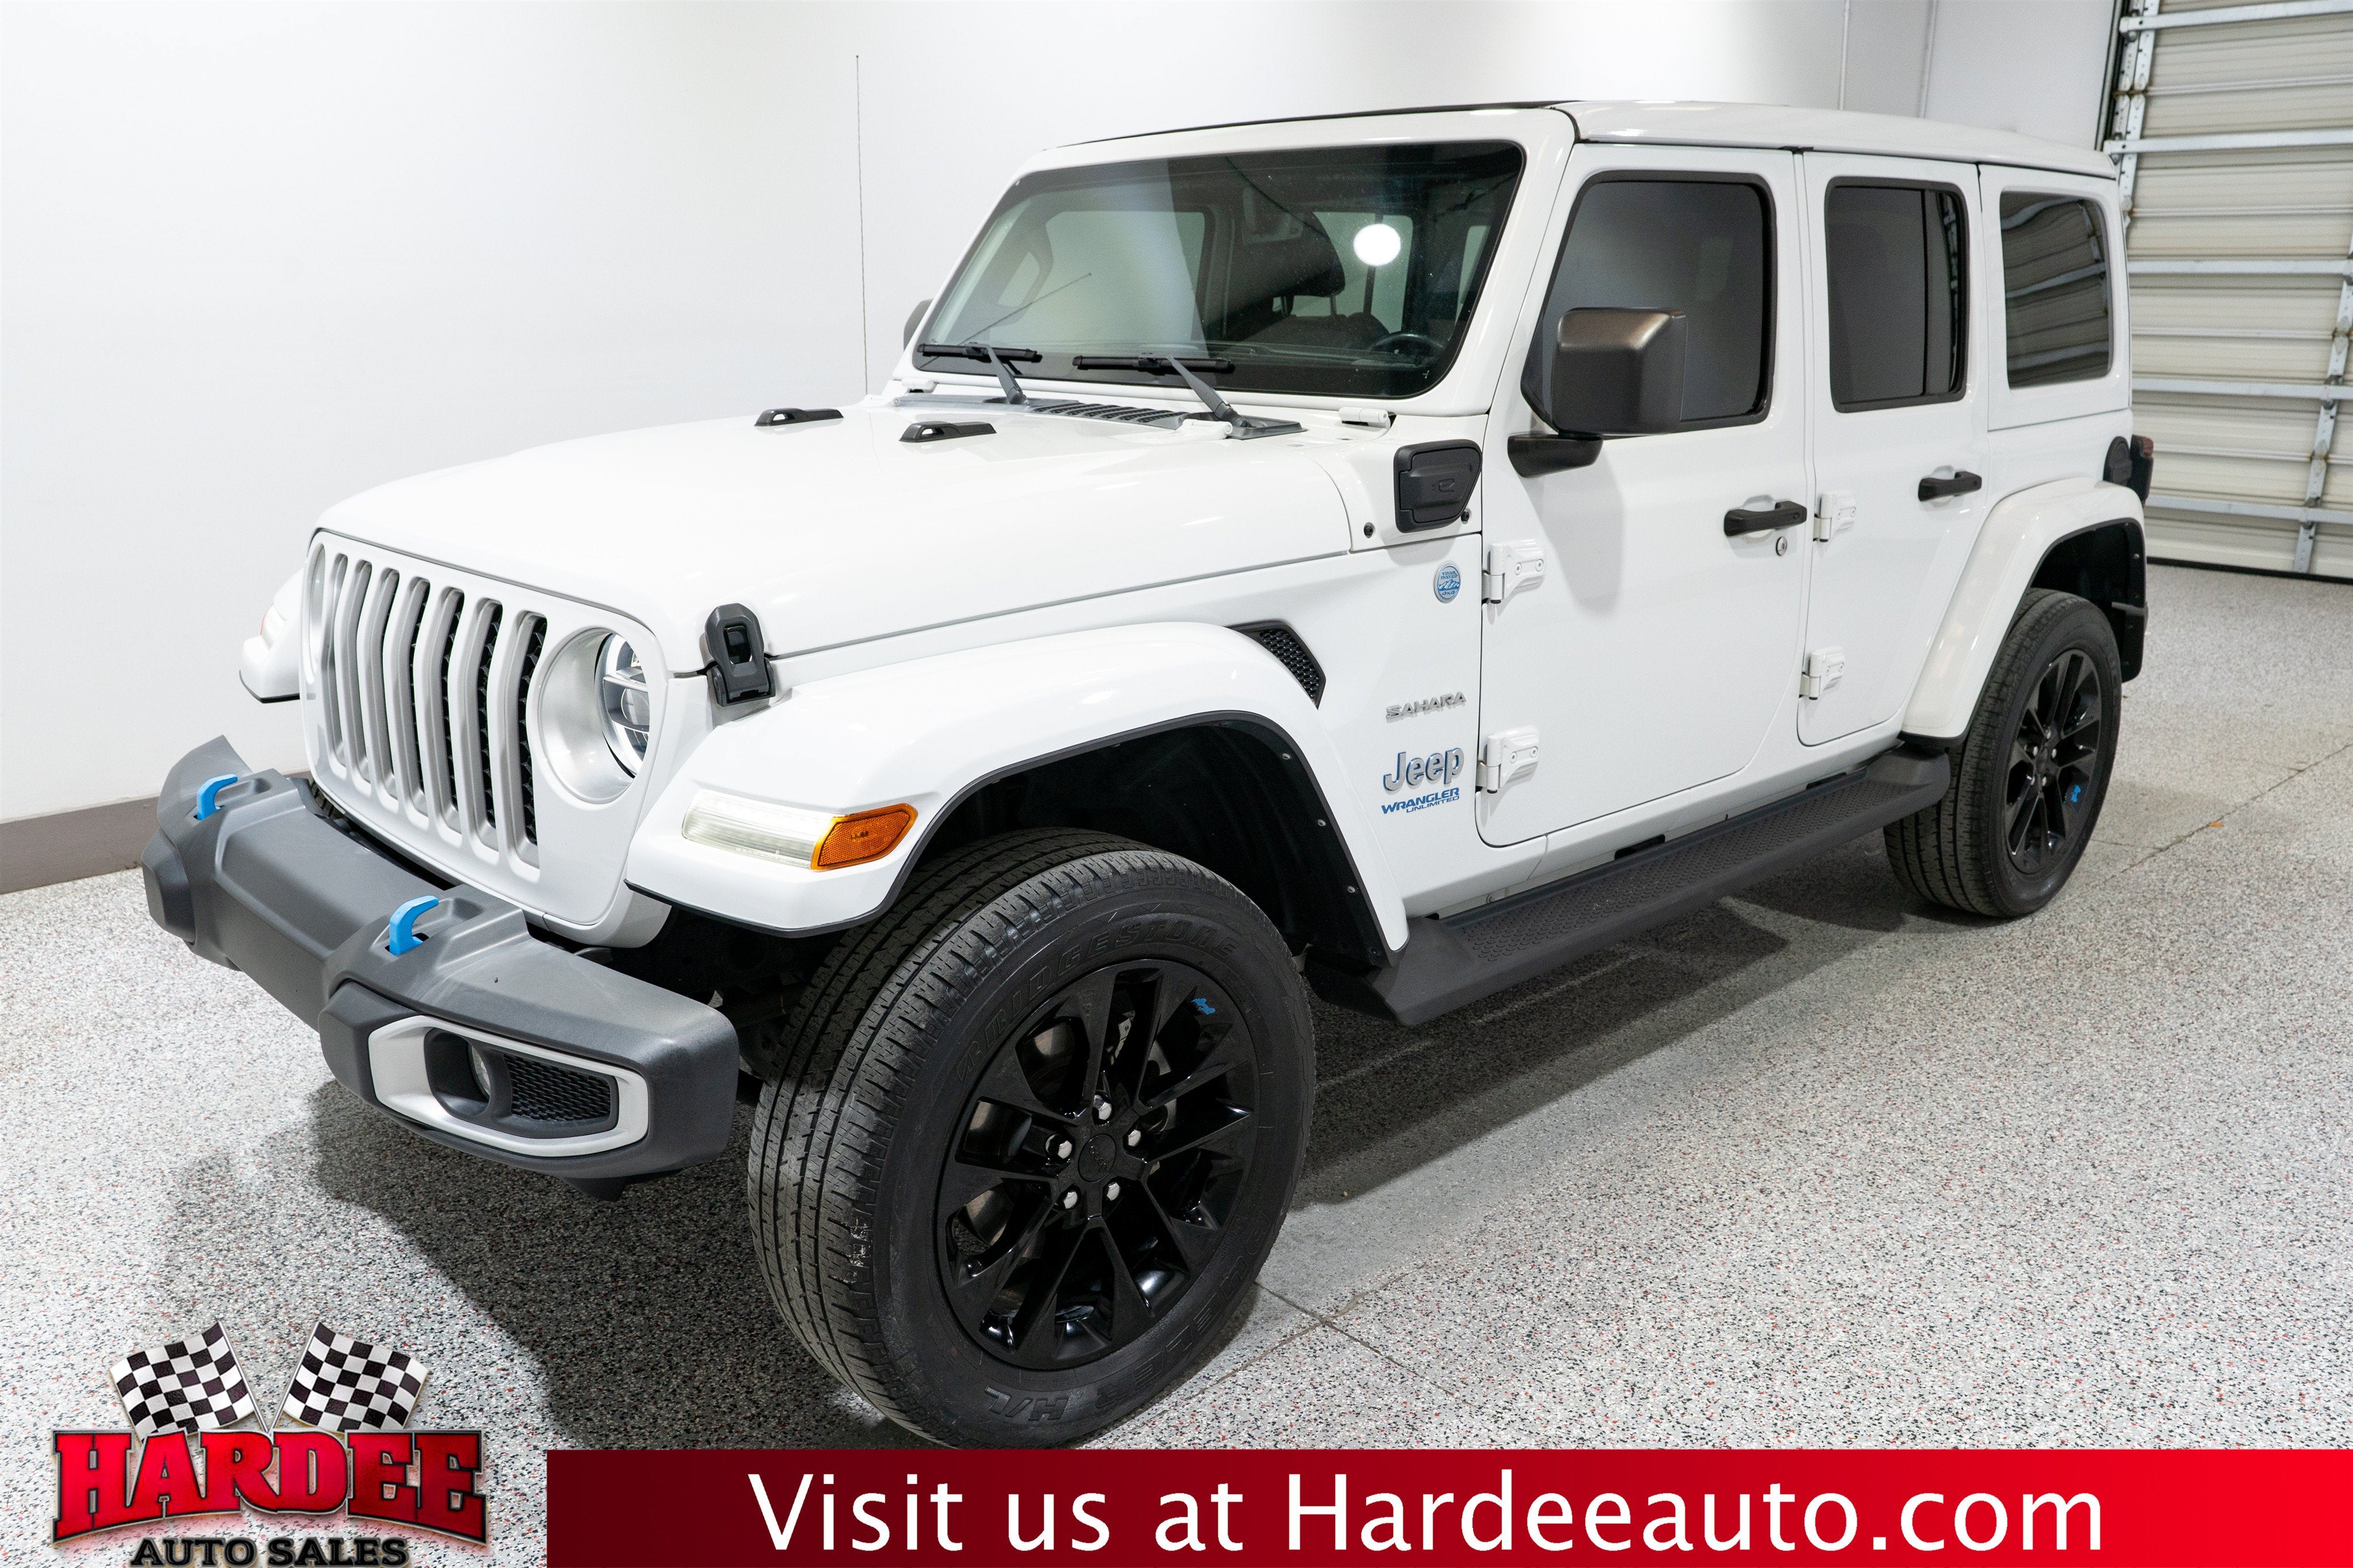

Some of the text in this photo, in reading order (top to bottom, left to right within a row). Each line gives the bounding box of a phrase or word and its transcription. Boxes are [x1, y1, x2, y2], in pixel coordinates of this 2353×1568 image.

[1386, 691, 1467, 720] SAHARA
[1383, 747, 1465, 792] Jeep
[1381, 787, 1460, 814] WRANGLER
[1406, 795, 1460, 814] UNLIMITED
[957, 920, 1241, 1081] BRIDGESTONE
